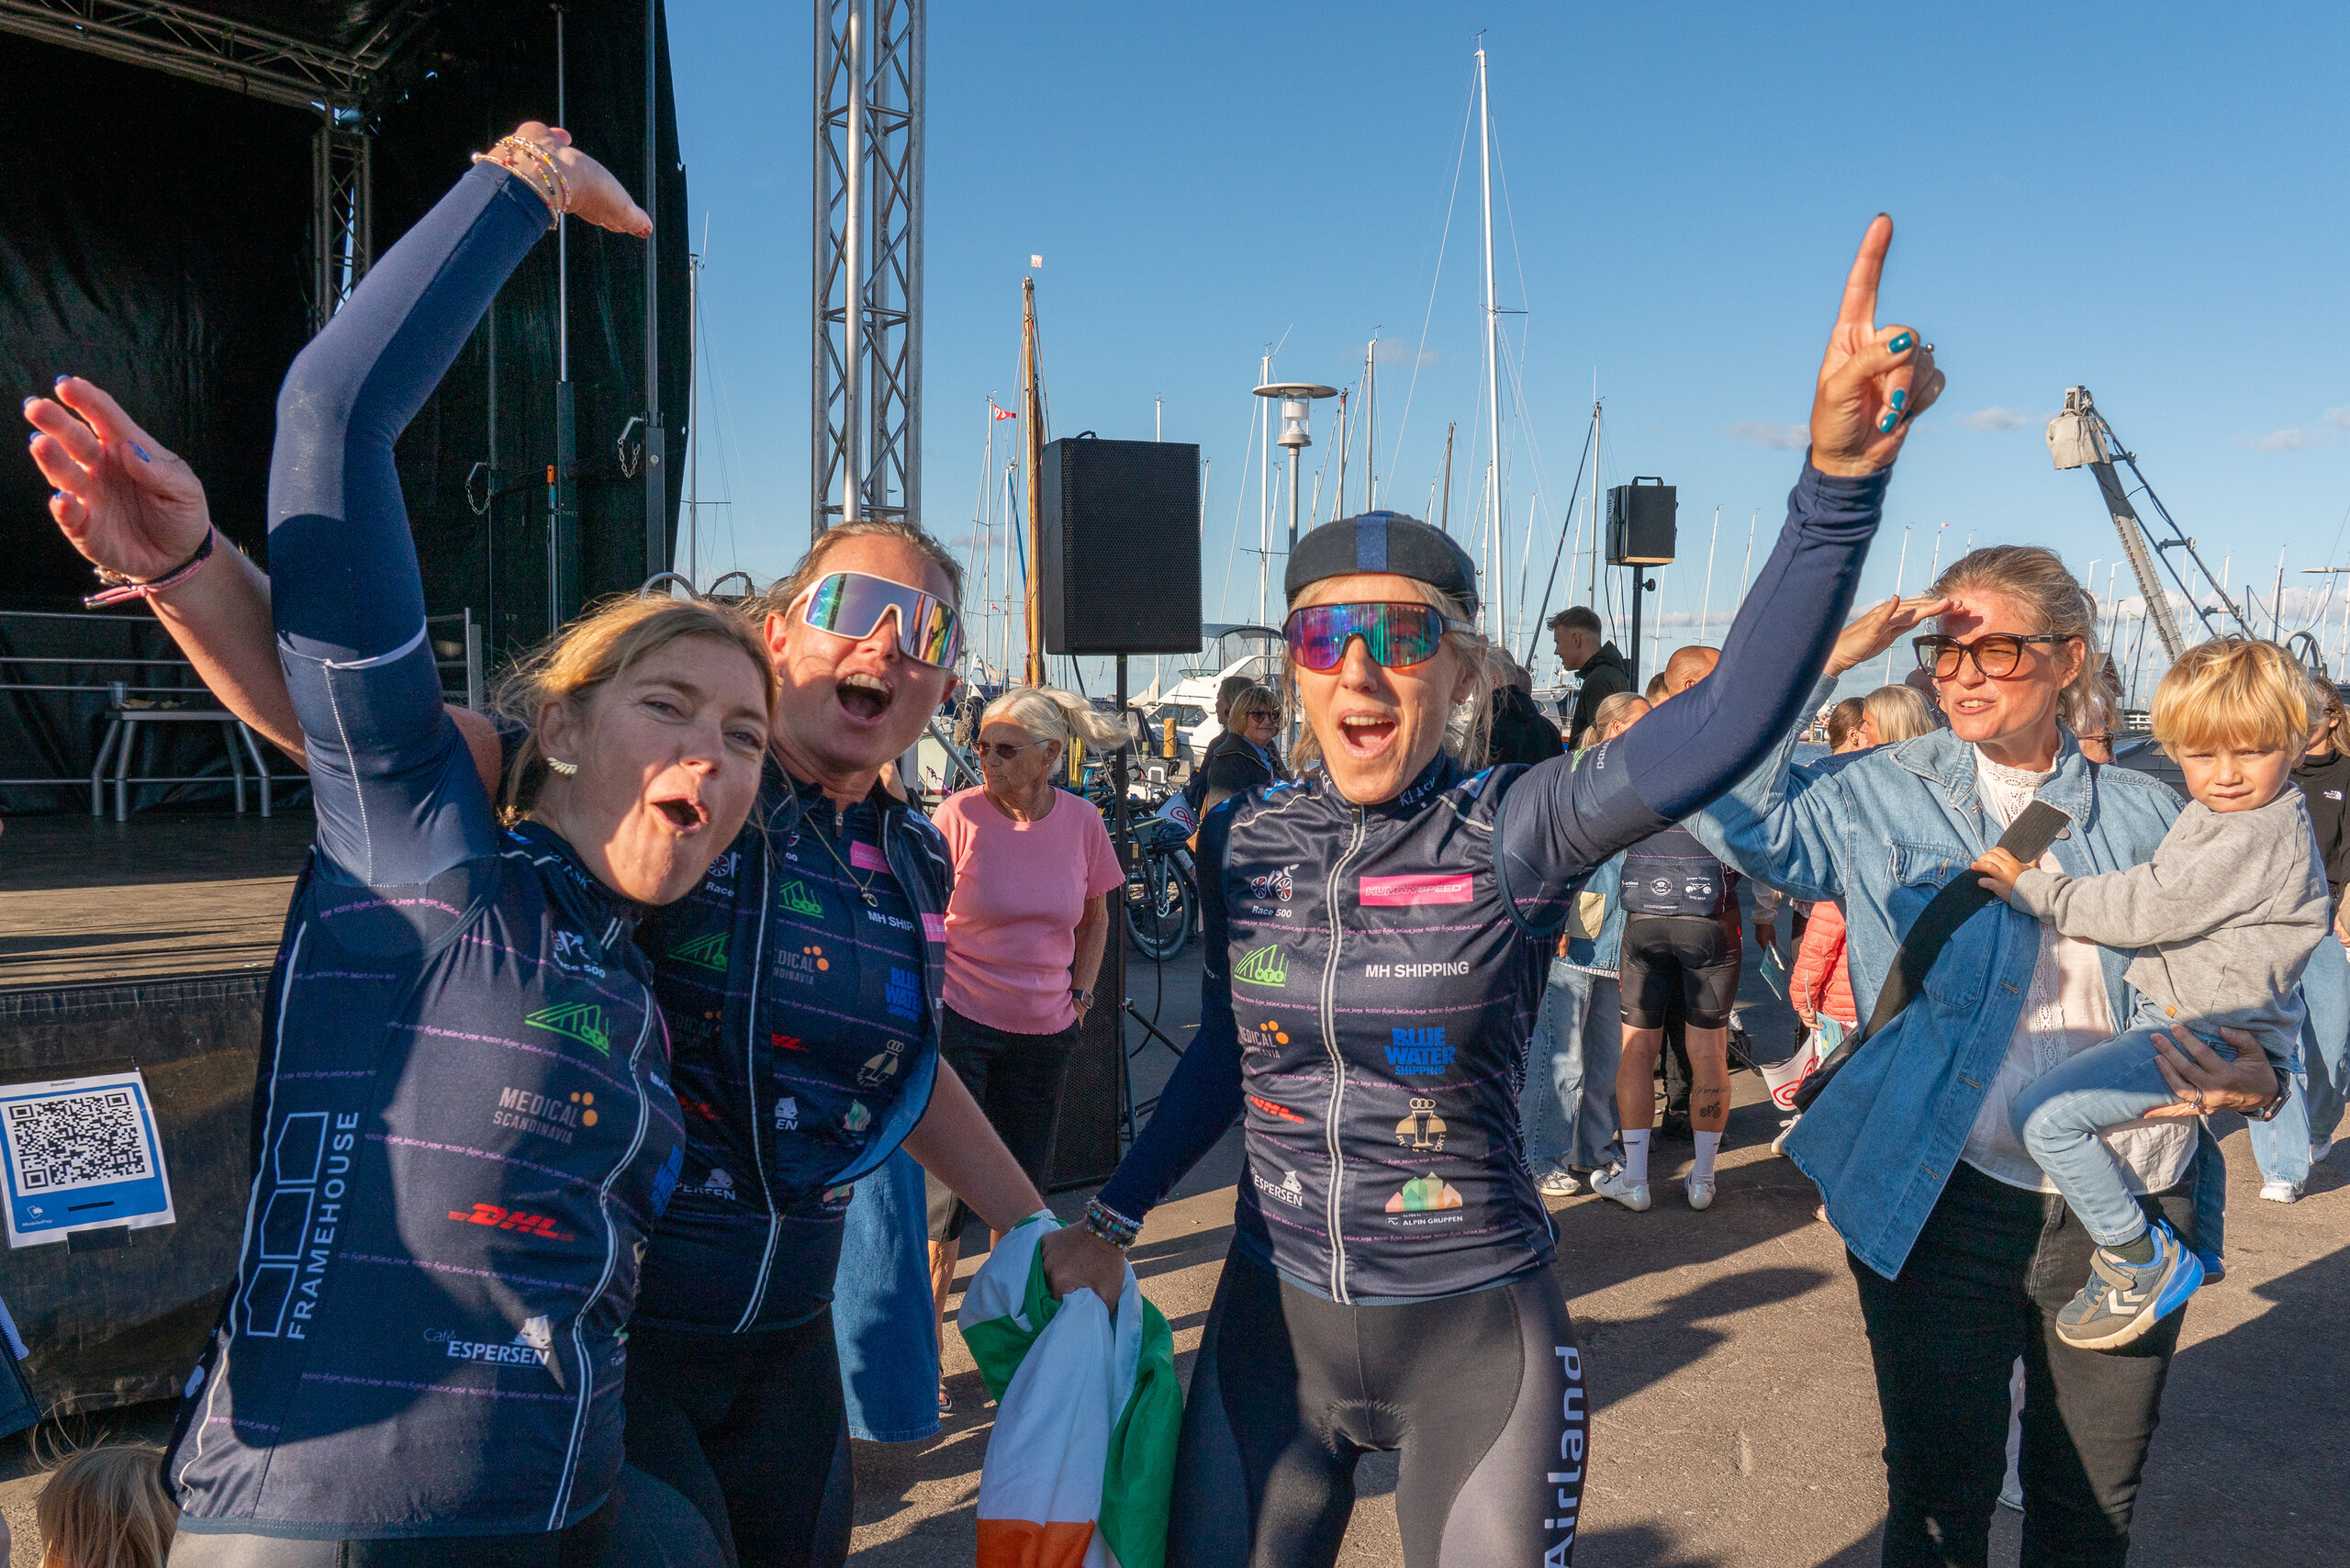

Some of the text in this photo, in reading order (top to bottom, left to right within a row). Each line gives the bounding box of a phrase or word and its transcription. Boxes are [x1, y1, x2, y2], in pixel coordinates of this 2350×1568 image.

[706, 881, 734, 897] Race
[867, 910, 887, 924] MH
[1251, 905, 1292, 918] Race 500
[583, 964, 606, 979] 500
[1365, 960, 1470, 978] MH SHIPPING
[1392, 1026, 1446, 1047] BLUE
[1383, 1045, 1457, 1065] WATER
[1394, 1065, 1446, 1076] SHIPPING
[498, 1086, 579, 1129] MEDICAL
[492, 1110, 574, 1146] SCANDINAVIA
[1254, 1174, 1303, 1207] ESPERSEN
[22, 1218, 53, 1227] MobilePay
[286, 1112, 359, 1339] FRAMEHOUSE
[459, 1203, 564, 1240] DHL
[1403, 1215, 1463, 1226] ALPIN GRUPPEN
[423, 1327, 457, 1343] Café
[447, 1339, 552, 1366] ESPERSEN
[1544, 1346, 1584, 1568] Airland
